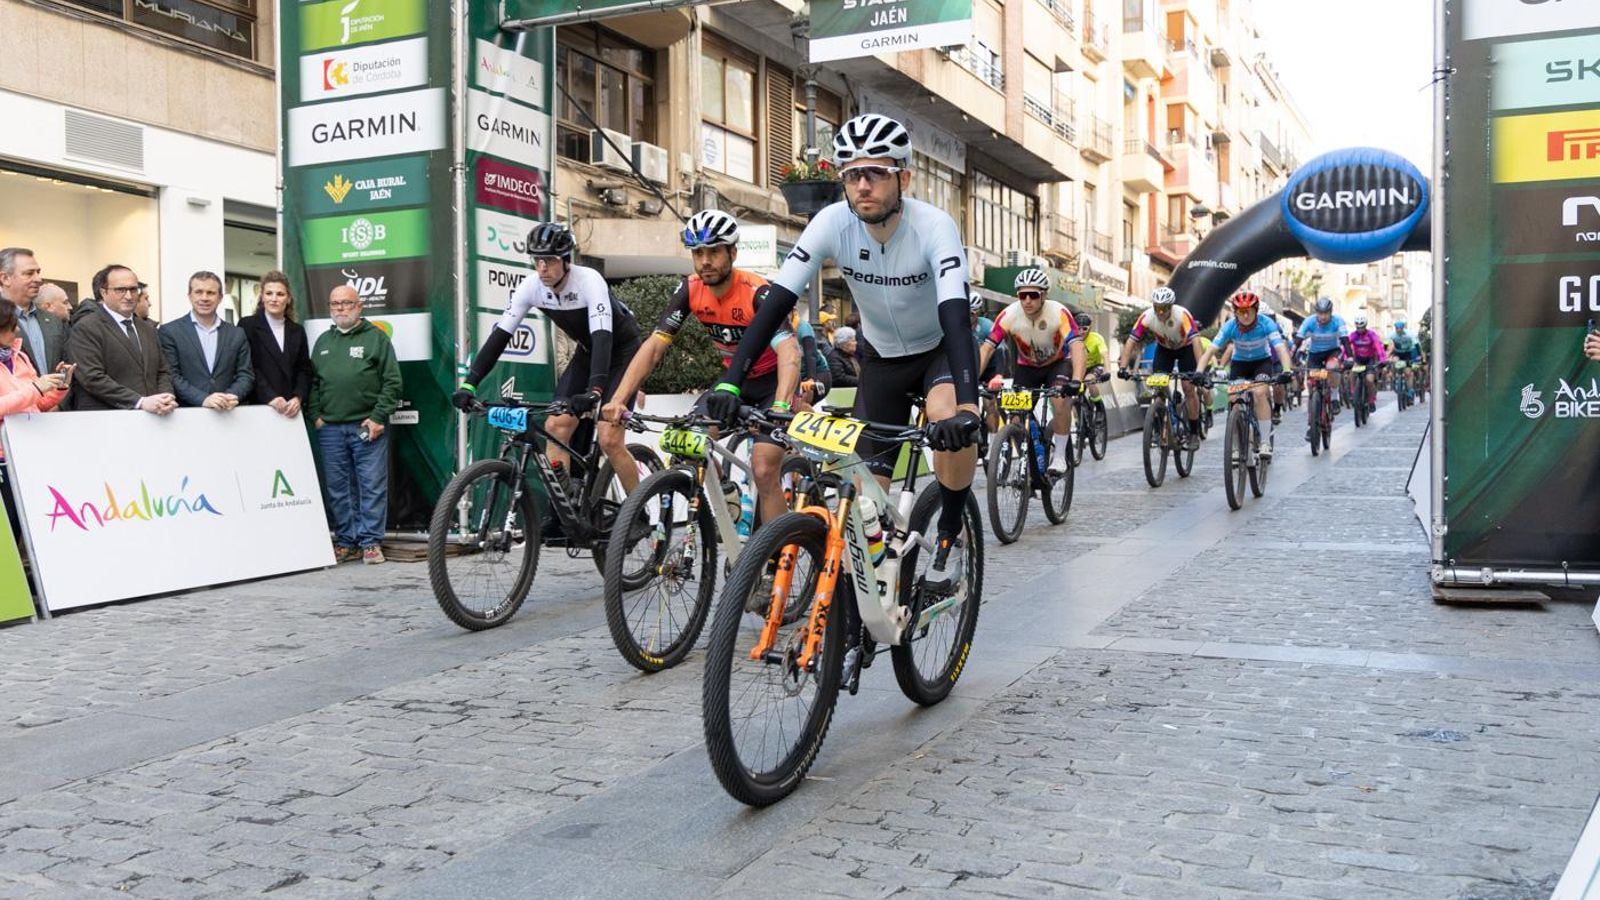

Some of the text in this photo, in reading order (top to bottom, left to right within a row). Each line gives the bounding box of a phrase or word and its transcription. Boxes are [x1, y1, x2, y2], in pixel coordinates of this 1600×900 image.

[135, 0, 247, 42] MURIANA
[870, 7, 908, 26] JAÉN
[861, 34, 919, 49] GARMIN
[353, 58, 401, 71] Diputación
[312, 111, 416, 144] GARMIN
[477, 114, 541, 147] GARMIN
[497, 174, 539, 197] IMDECO
[1296, 187, 1409, 210] GARMIN
[1188, 259, 1237, 271] garmin.com
[842, 266, 928, 287] Pedalmoto
[508, 330, 529, 350] UZ
[491, 408, 525, 426] 406-2
[795, 413, 857, 447] 241-2
[46, 475, 223, 532] Andalucía
